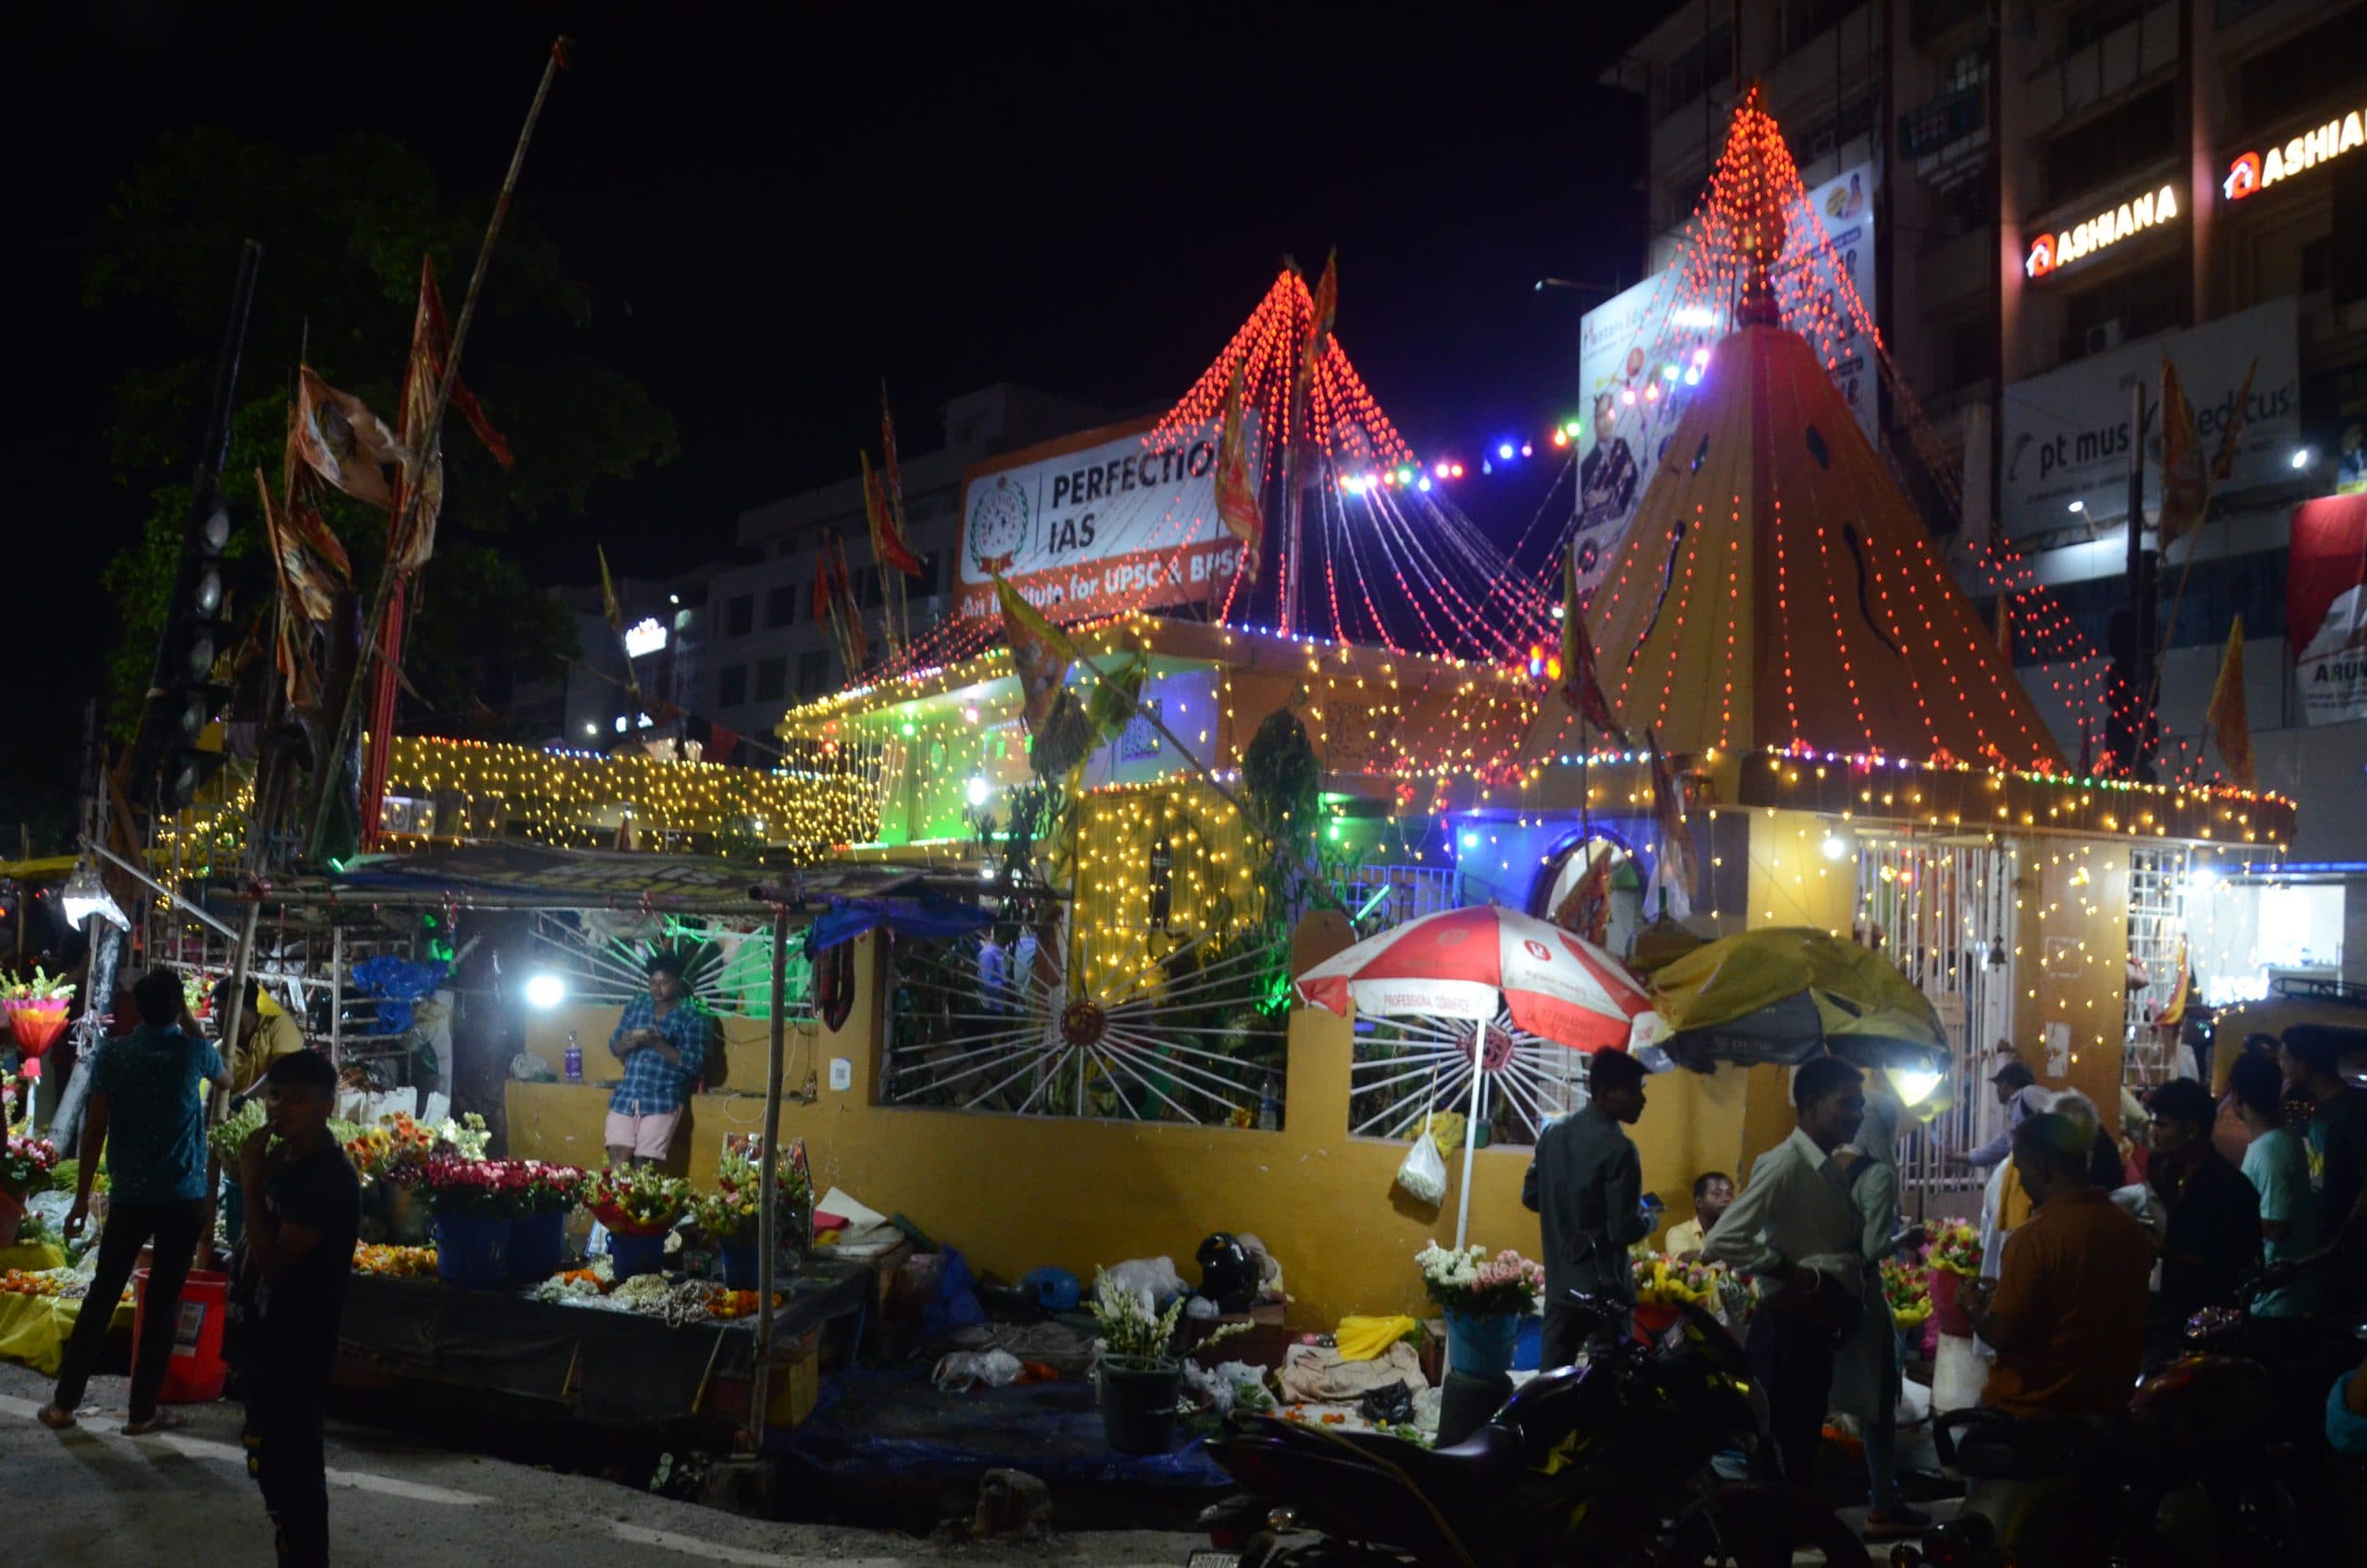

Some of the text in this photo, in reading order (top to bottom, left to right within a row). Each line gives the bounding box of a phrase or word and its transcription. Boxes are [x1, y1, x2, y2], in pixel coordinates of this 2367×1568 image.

[2262, 107, 2367, 189] ASHIA
[2055, 185, 2177, 267] ASHIANA
[1052, 437, 1223, 508] PERFECTIO
[1049, 513, 1096, 555] IAS
[962, 594, 986, 618] An
[1070, 572, 1099, 602] for
[1105, 560, 1161, 594] UPSC
[1168, 556, 1183, 585] &
